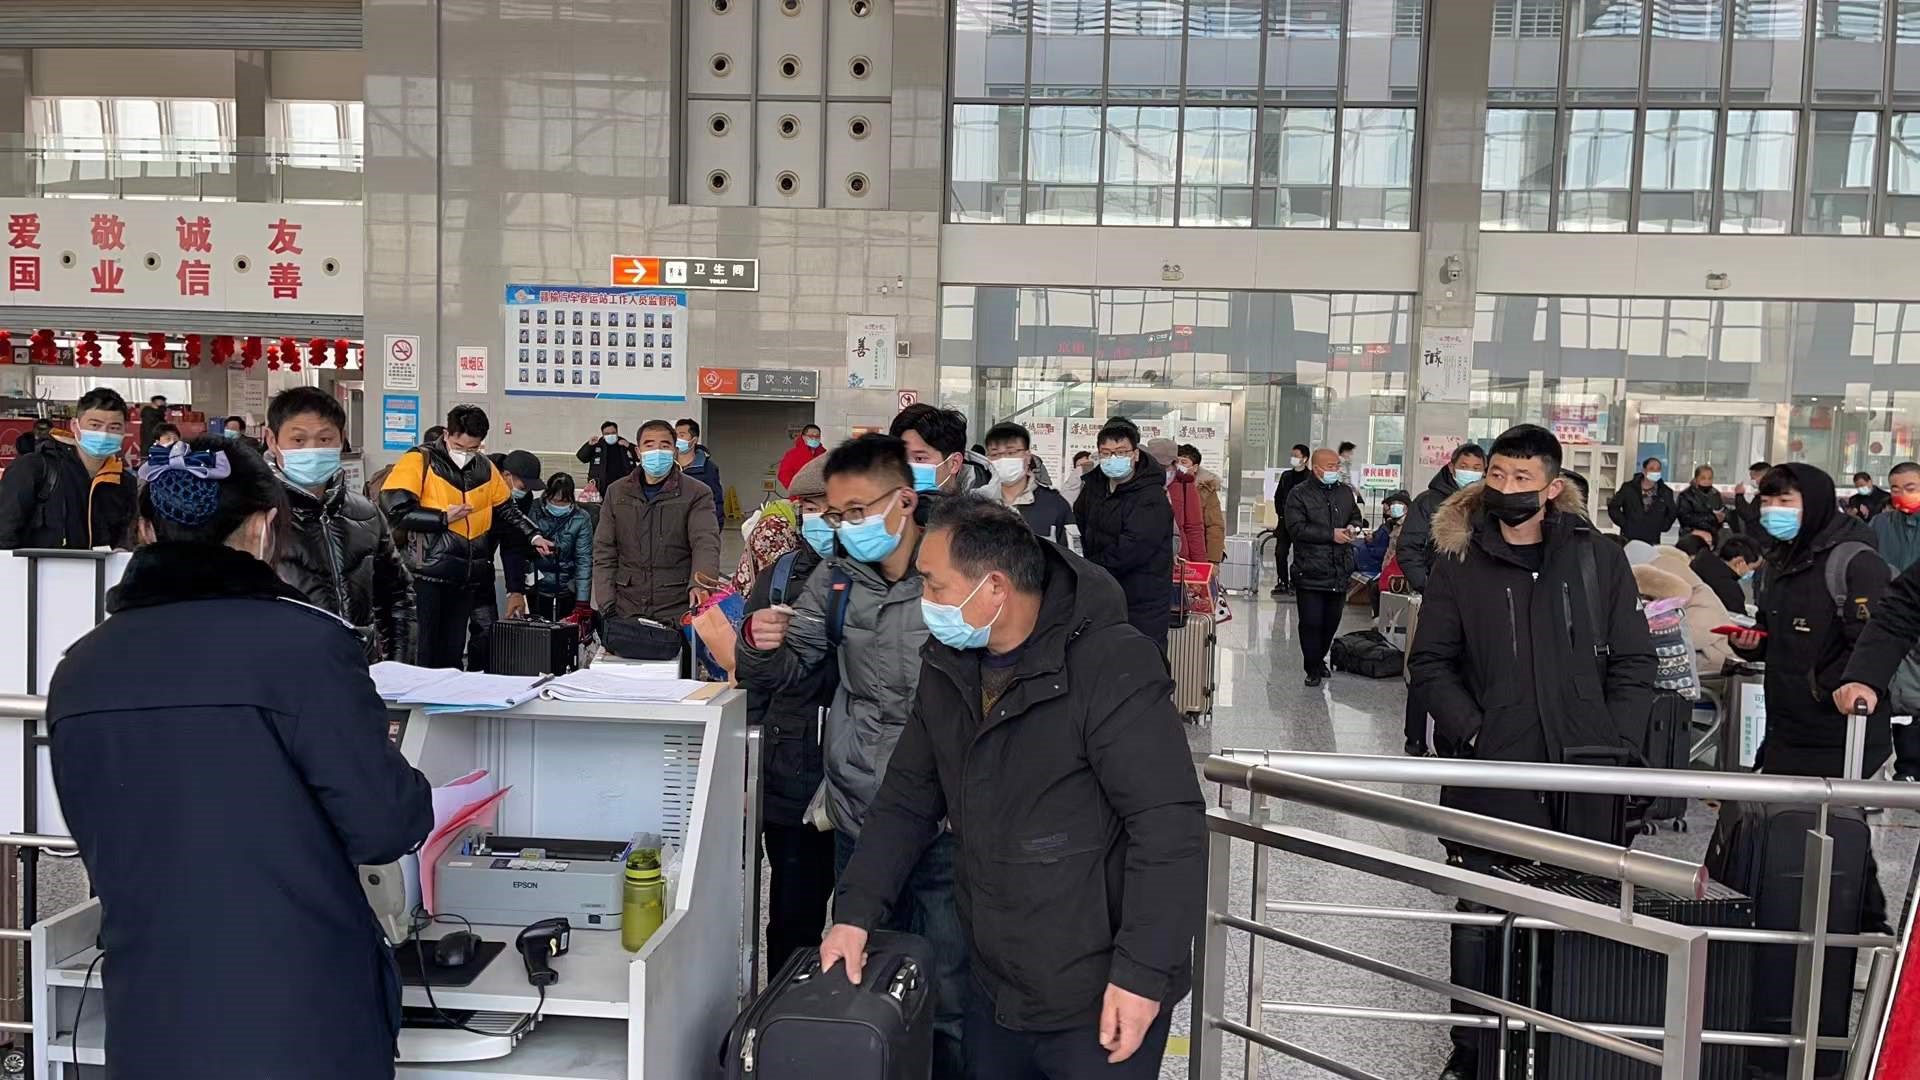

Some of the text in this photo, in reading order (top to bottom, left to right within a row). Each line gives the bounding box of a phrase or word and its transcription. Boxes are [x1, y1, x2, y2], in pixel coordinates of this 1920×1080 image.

[8, 213, 41, 292] 爱国
[90, 214, 125, 294] 敬业
[176, 215, 213, 296] 诚信
[268, 218, 303, 299] 友善
[694, 263, 745, 277] 卫生间
[765, 374, 809, 385] 饮水处
[512, 881, 538, 889] EPSON
